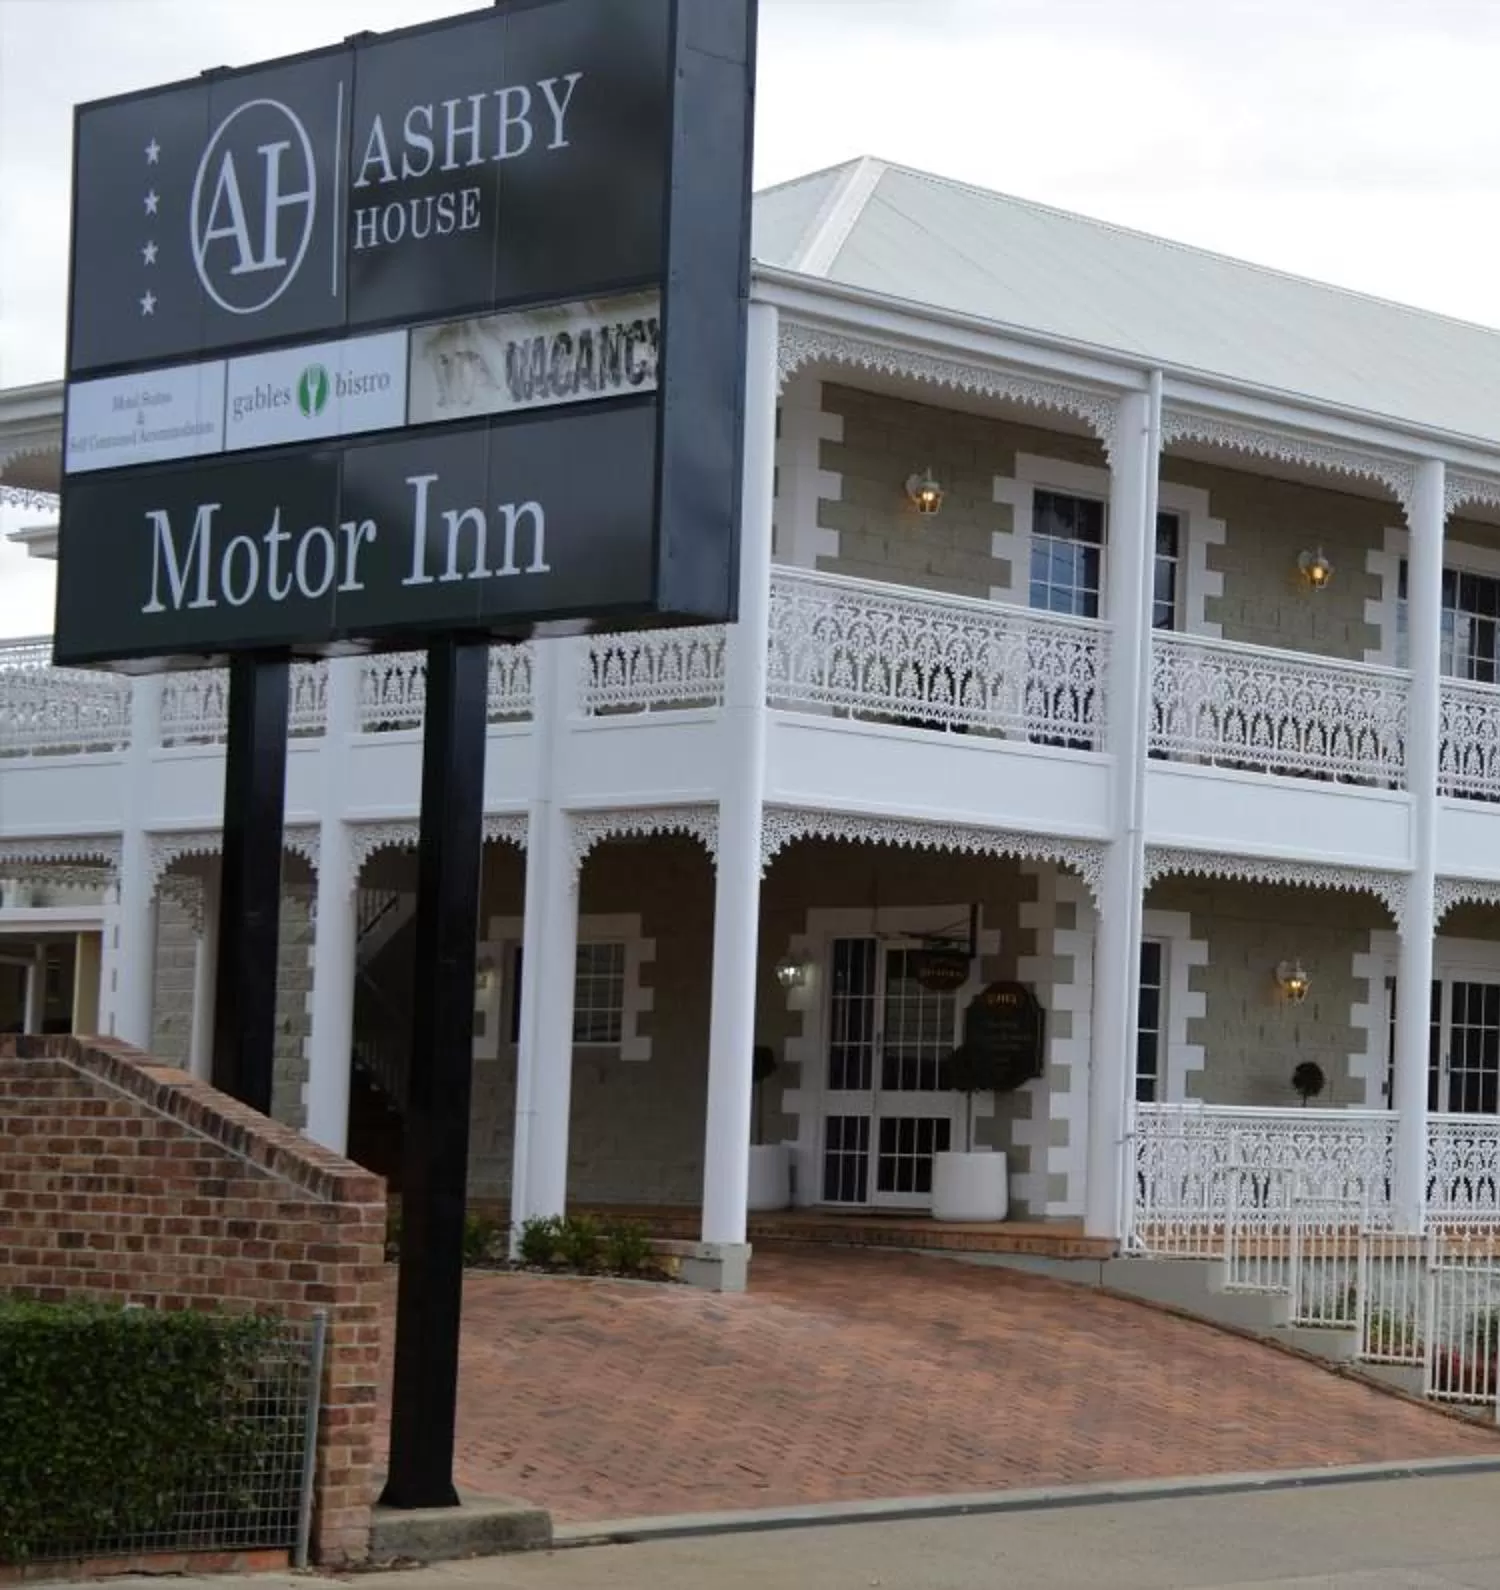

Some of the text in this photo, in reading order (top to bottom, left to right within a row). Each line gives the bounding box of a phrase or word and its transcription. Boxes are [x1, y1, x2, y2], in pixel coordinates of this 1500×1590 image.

[353, 72, 583, 188] ASHBY
[353, 187, 482, 250] HOUSE
[232, 369, 391, 422] gables bistro
[141, 474, 551, 612] Motor Inn
